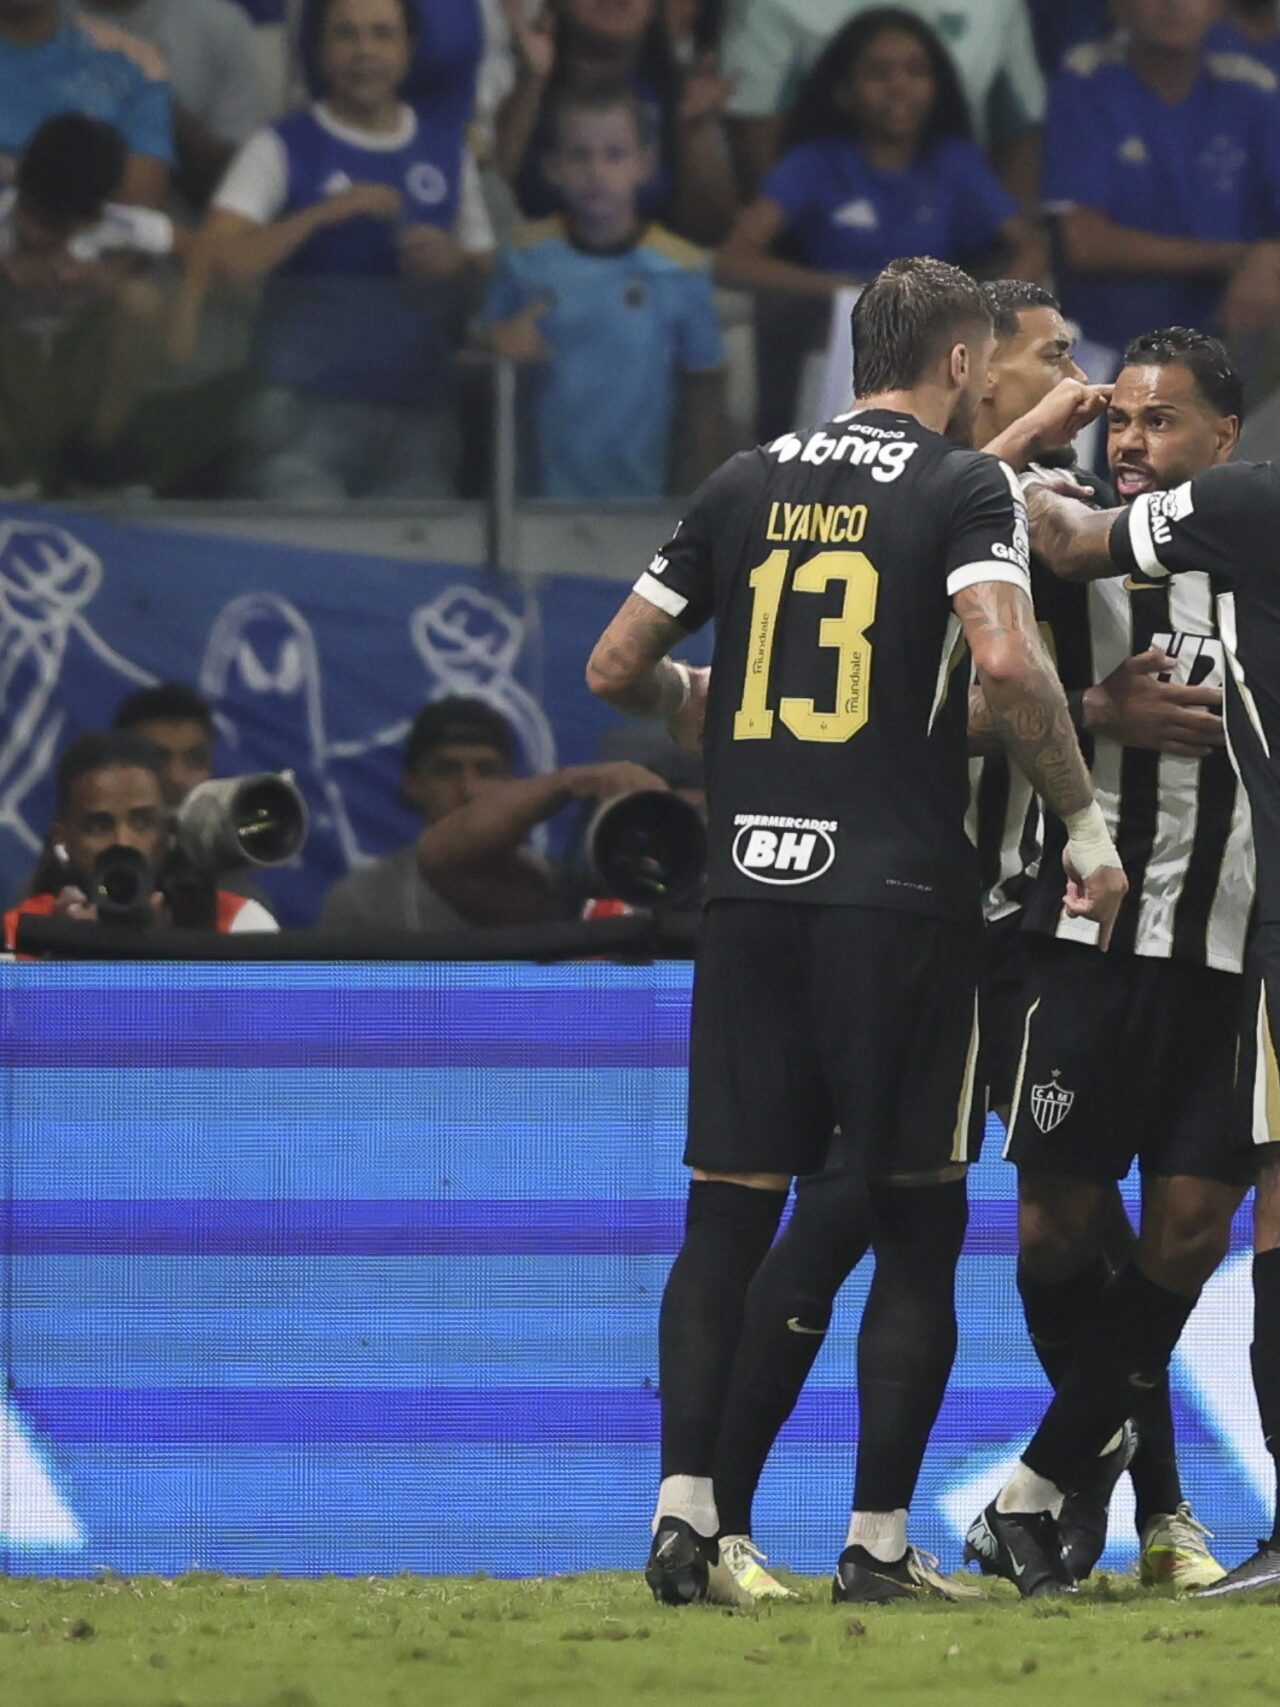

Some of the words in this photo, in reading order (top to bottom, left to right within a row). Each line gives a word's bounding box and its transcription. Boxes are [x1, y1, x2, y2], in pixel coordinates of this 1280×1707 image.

[800, 431, 919, 483] bmg
[766, 501, 869, 544] LYANCO
[733, 549, 879, 743] 13
[844, 651, 863, 714] mundiale
[743, 829, 818, 872] BH
